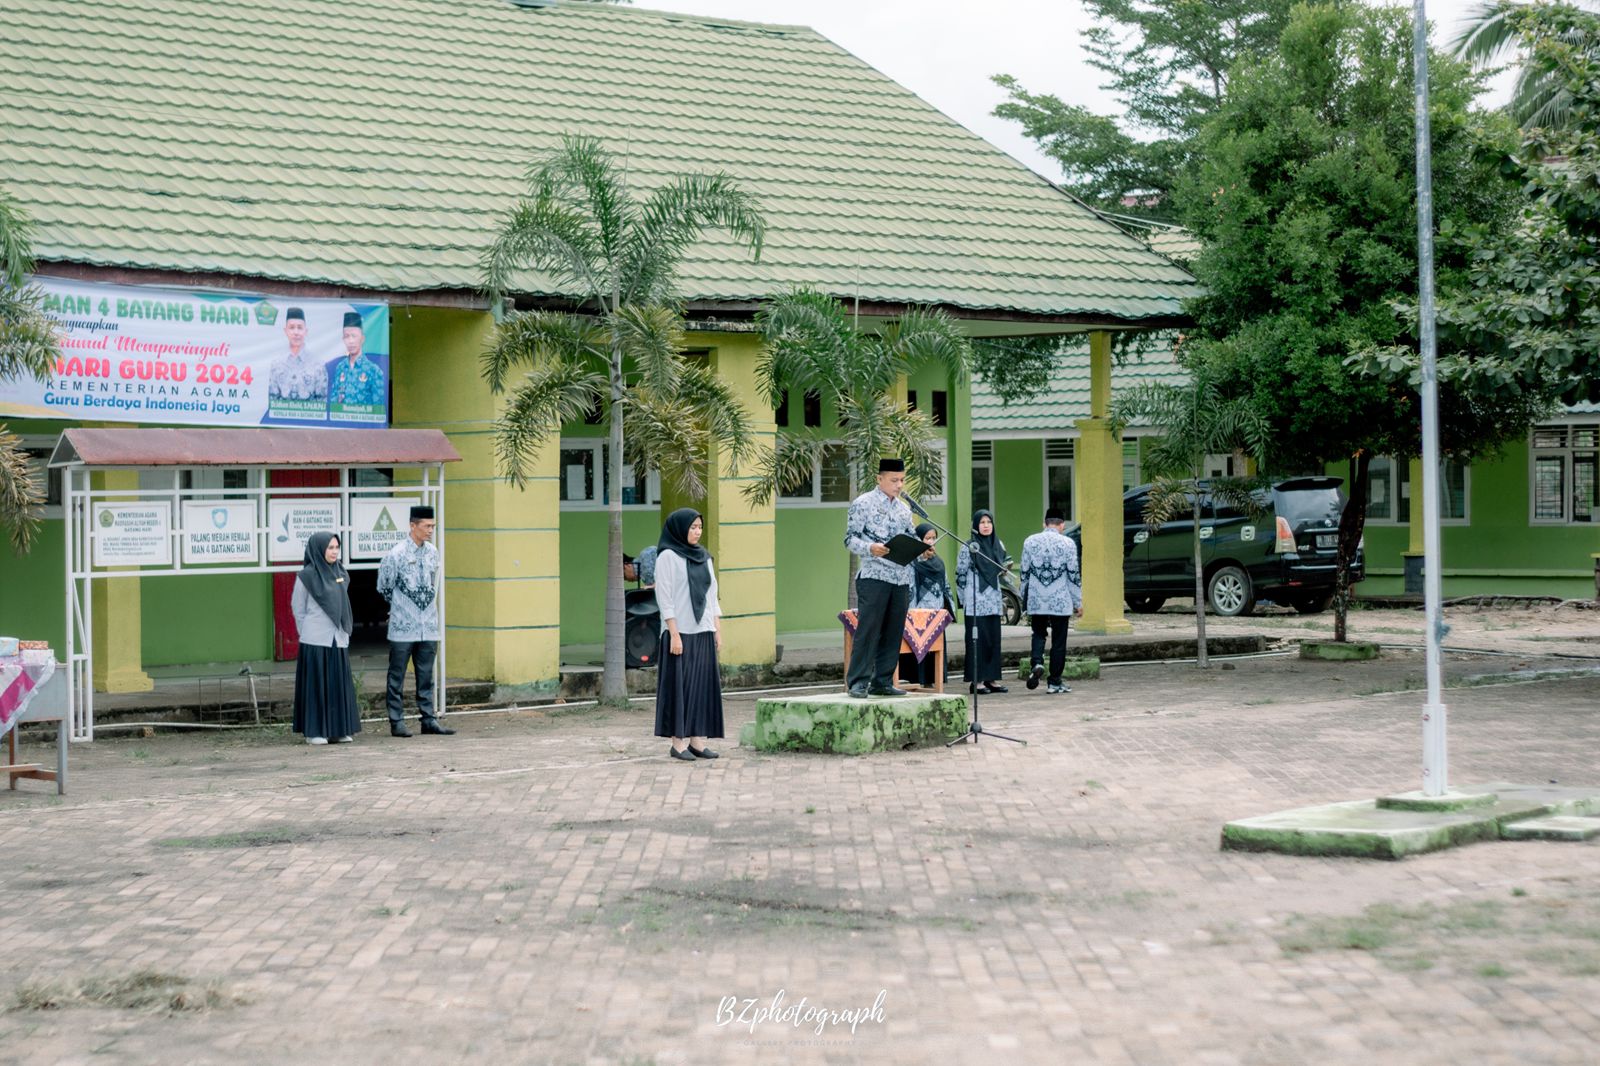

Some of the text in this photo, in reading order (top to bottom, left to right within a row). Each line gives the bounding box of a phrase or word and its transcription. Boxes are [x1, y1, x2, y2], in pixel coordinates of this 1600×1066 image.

[43, 293, 249, 326] MAN 4 BATANG HARI
[119, 359, 187, 382] GURU
[195, 363, 254, 385] 2024
[46, 380, 250, 399] KEMENTERIAN AGAMA
[44, 392, 240, 415] Guru Berdaya Indonesia Jaya
[191, 532, 250, 542] PALANG MERAH REMAJA
[358, 531, 408, 541] USAHA KESEHATAN SEKO
[191, 543, 251, 554] MAN 4 BATANG HARI
[358, 542, 399, 552] MAN 4 BATAN
